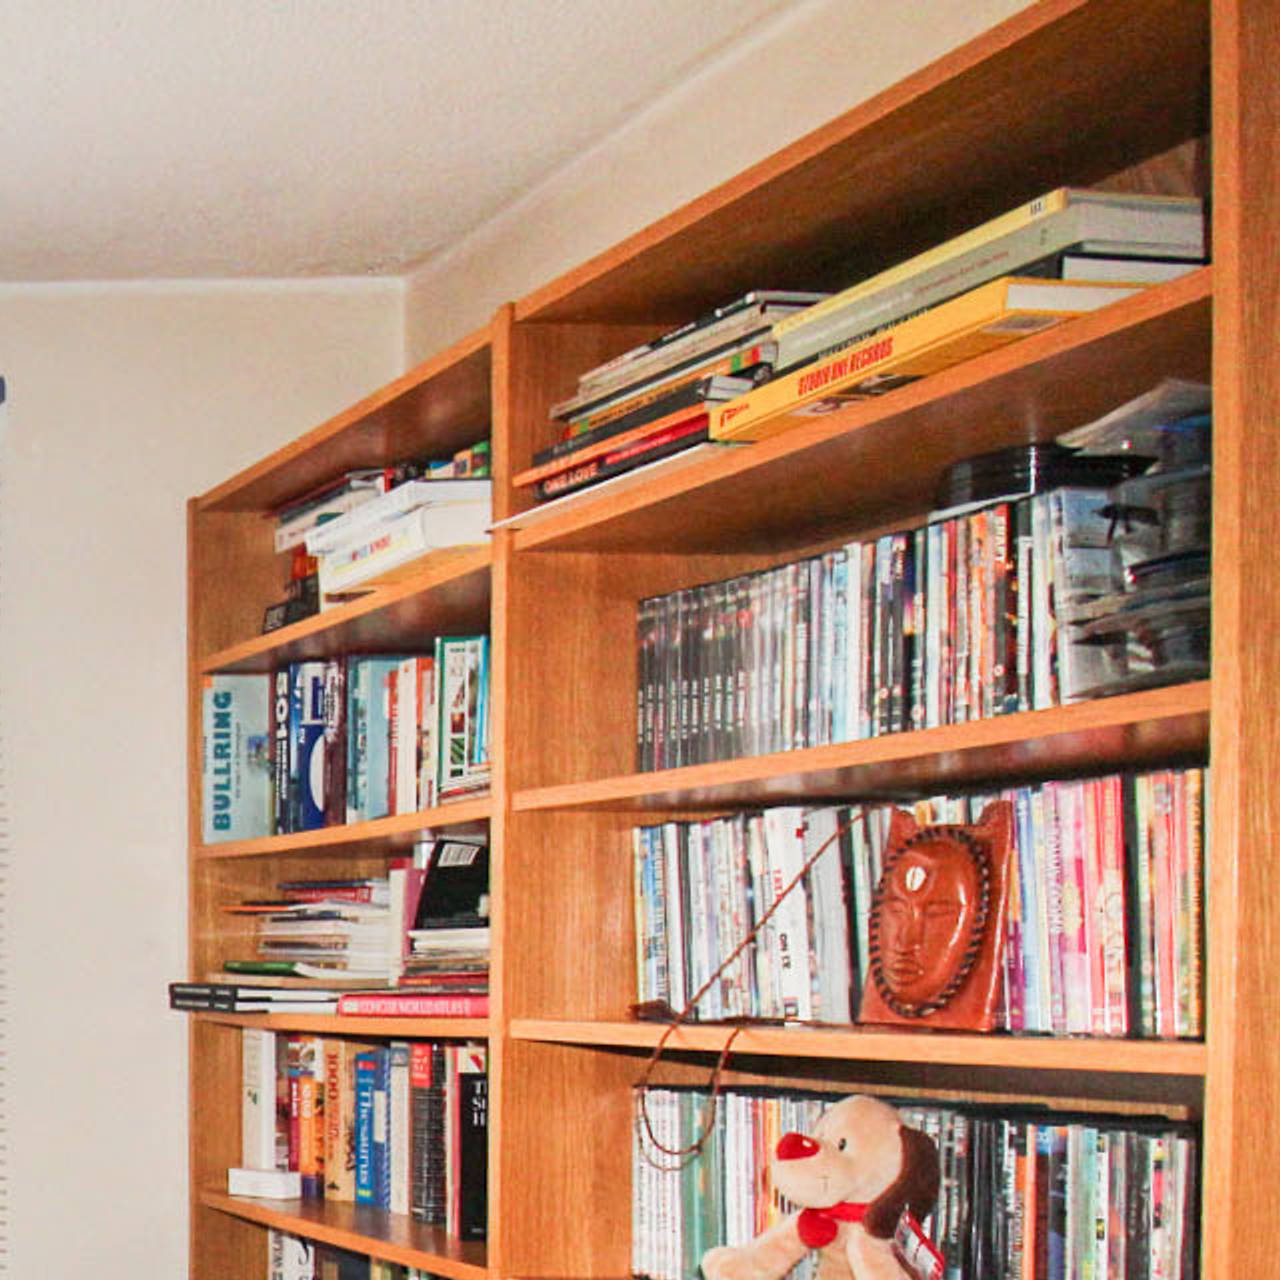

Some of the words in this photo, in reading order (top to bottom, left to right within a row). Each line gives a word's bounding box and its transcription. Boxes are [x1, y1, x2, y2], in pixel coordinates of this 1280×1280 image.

[849, 337, 895, 376] RECORDS
[276, 671, 288, 739] 501
[213, 690, 232, 831] BULLRING
[358, 1084, 370, 1187] Thesaurus
